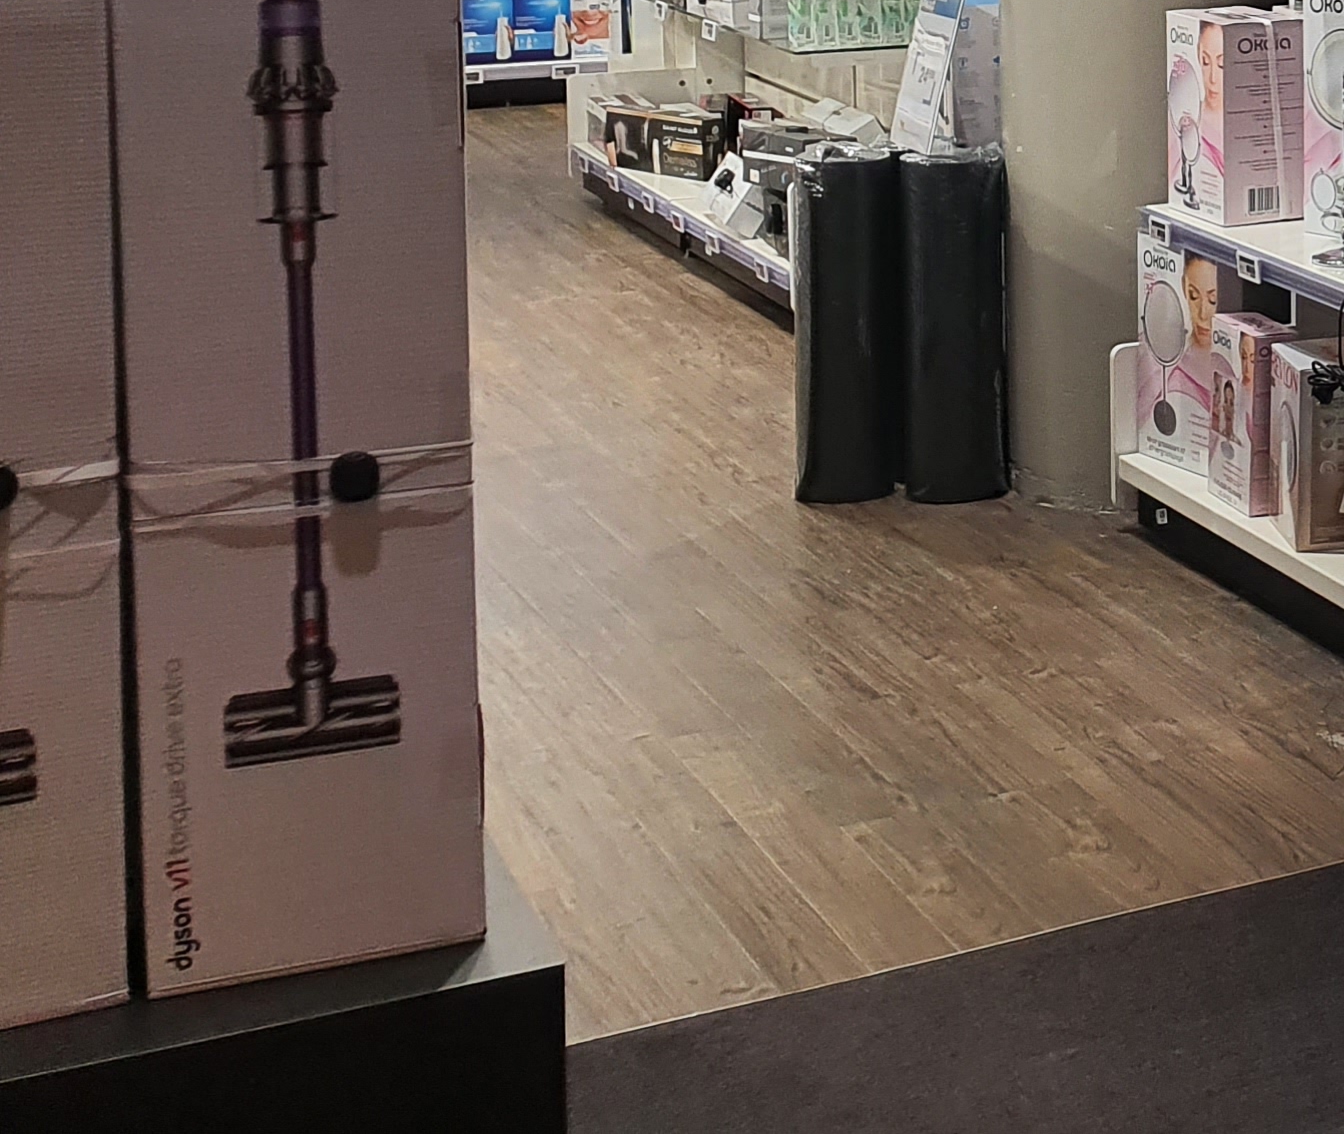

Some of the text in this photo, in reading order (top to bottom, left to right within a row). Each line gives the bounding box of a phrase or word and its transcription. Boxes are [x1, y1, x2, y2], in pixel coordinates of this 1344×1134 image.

[161, 657, 201, 972] dyson v11 torque drive extra
